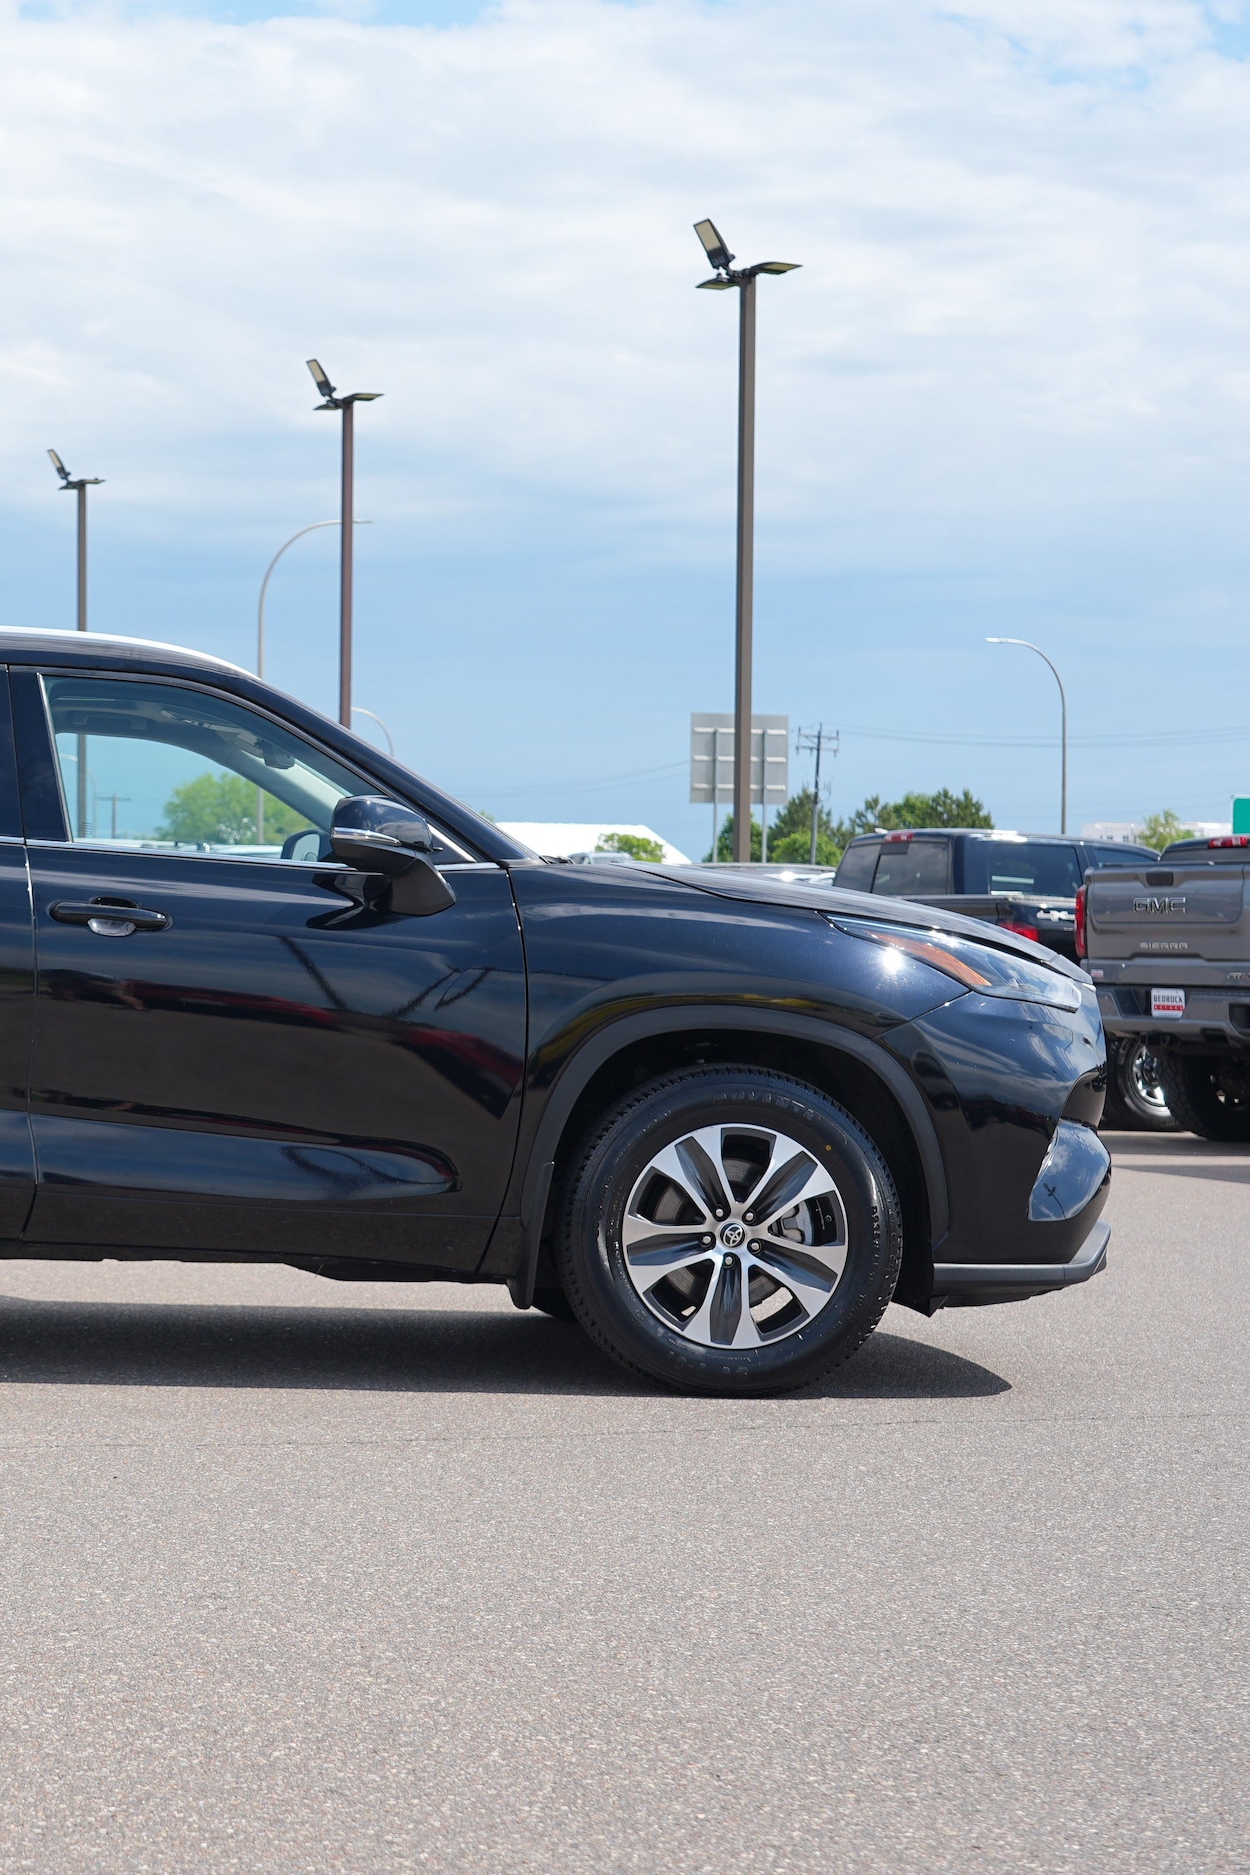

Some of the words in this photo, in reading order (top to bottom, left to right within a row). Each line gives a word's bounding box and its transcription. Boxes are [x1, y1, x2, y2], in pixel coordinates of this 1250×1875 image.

[1133, 897, 1186, 914] GMC
[1139, 942, 1188, 950] SIERRA
[1153, 994, 1183, 1003] BEDROCK
